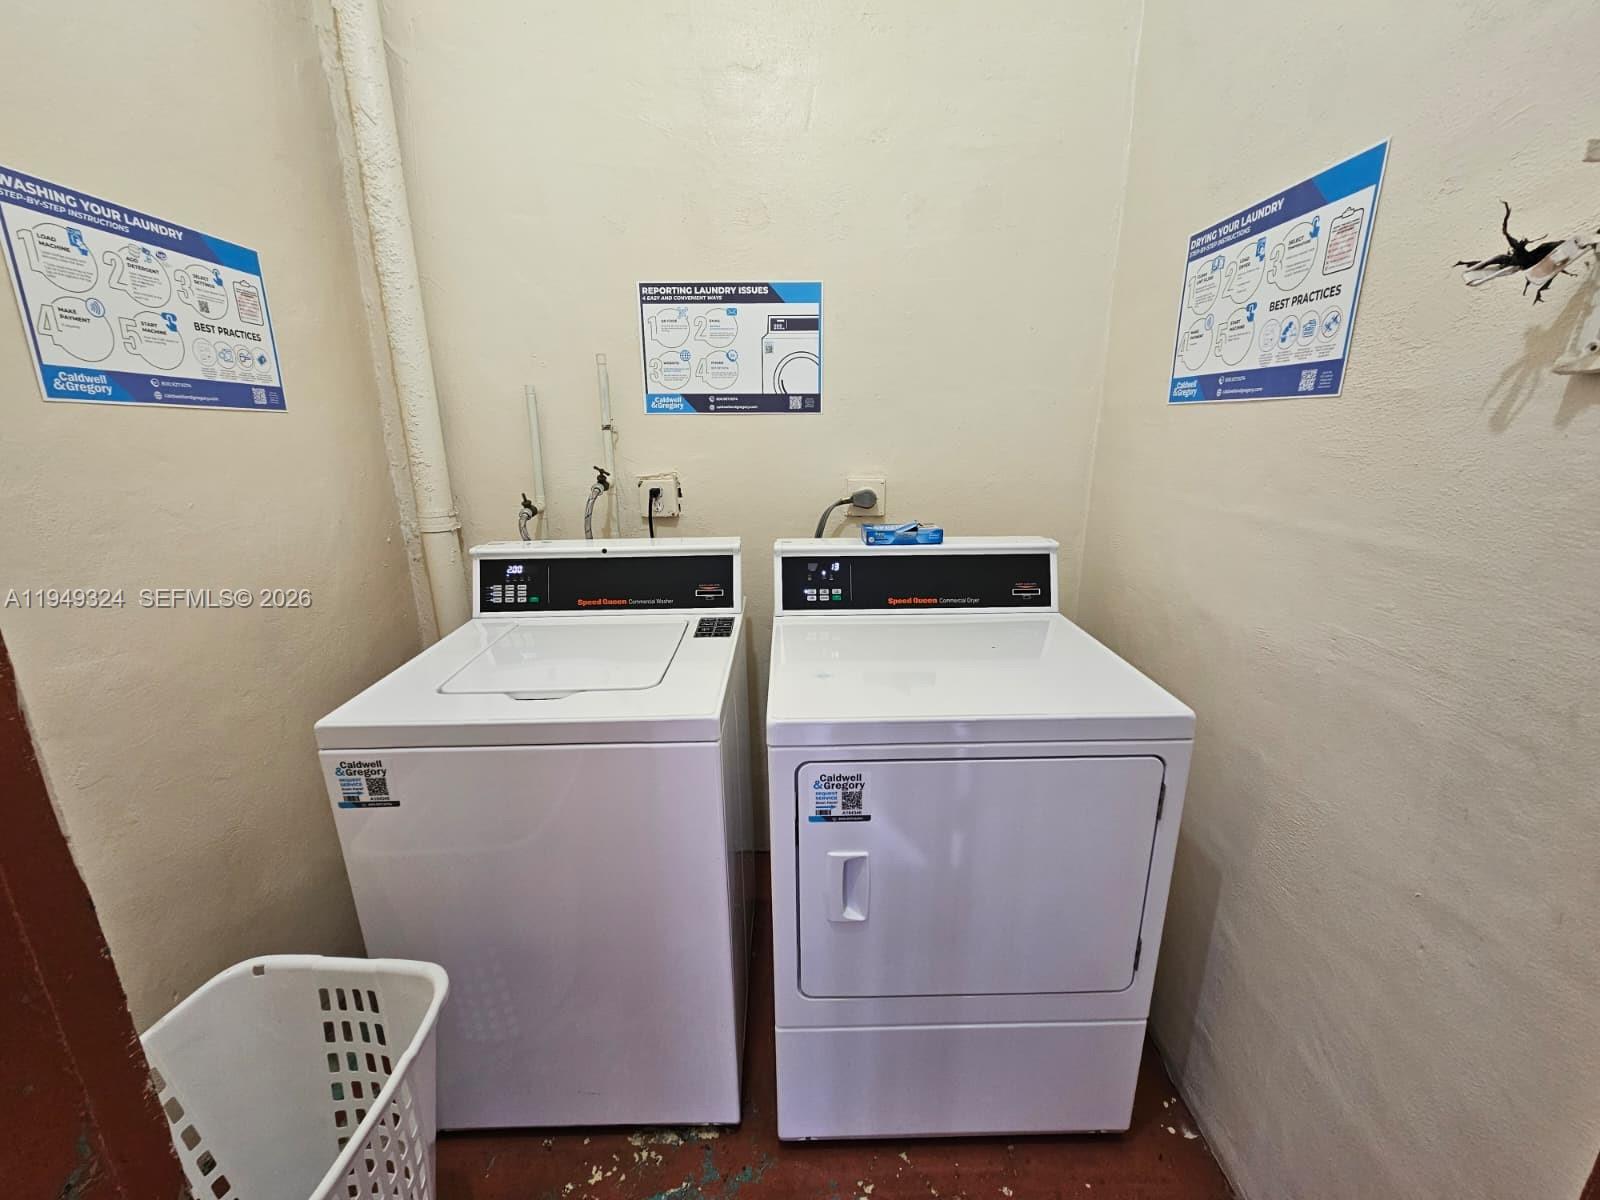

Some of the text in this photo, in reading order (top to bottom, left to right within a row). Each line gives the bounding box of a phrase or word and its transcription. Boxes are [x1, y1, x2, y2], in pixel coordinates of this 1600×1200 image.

[68, 209, 130, 233] INSTRUCTIONS
[79, 199, 121, 222] YOUR
[124, 214, 183, 240] LAUNDRY
[1190, 198, 1285, 250] DRYING YOUR LAUNDRY
[38, 241, 71, 252] MACHINE
[641, 286, 769, 295] REPORTING LAUNDRY ISSUES
[1269, 284, 1342, 312] BEST PRACTICES
[193, 321, 263, 342] BEST PRACTICES
[58, 371, 108, 385] Caldwell
[53, 378, 113, 396] &Gregory
[831, 562, 840, 572] 13
[577, 598, 602, 606] Speed
[602, 598, 627, 606] Queen
[888, 597, 912, 606] Speed
[913, 597, 938, 605] Queen
[967, 597, 980, 605] Dryer
[339, 760, 383, 769] Caldwell
[335, 767, 387, 778] &Gregory
[819, 773, 862, 782] Caldwell
[813, 780, 866, 791] &Gregory
